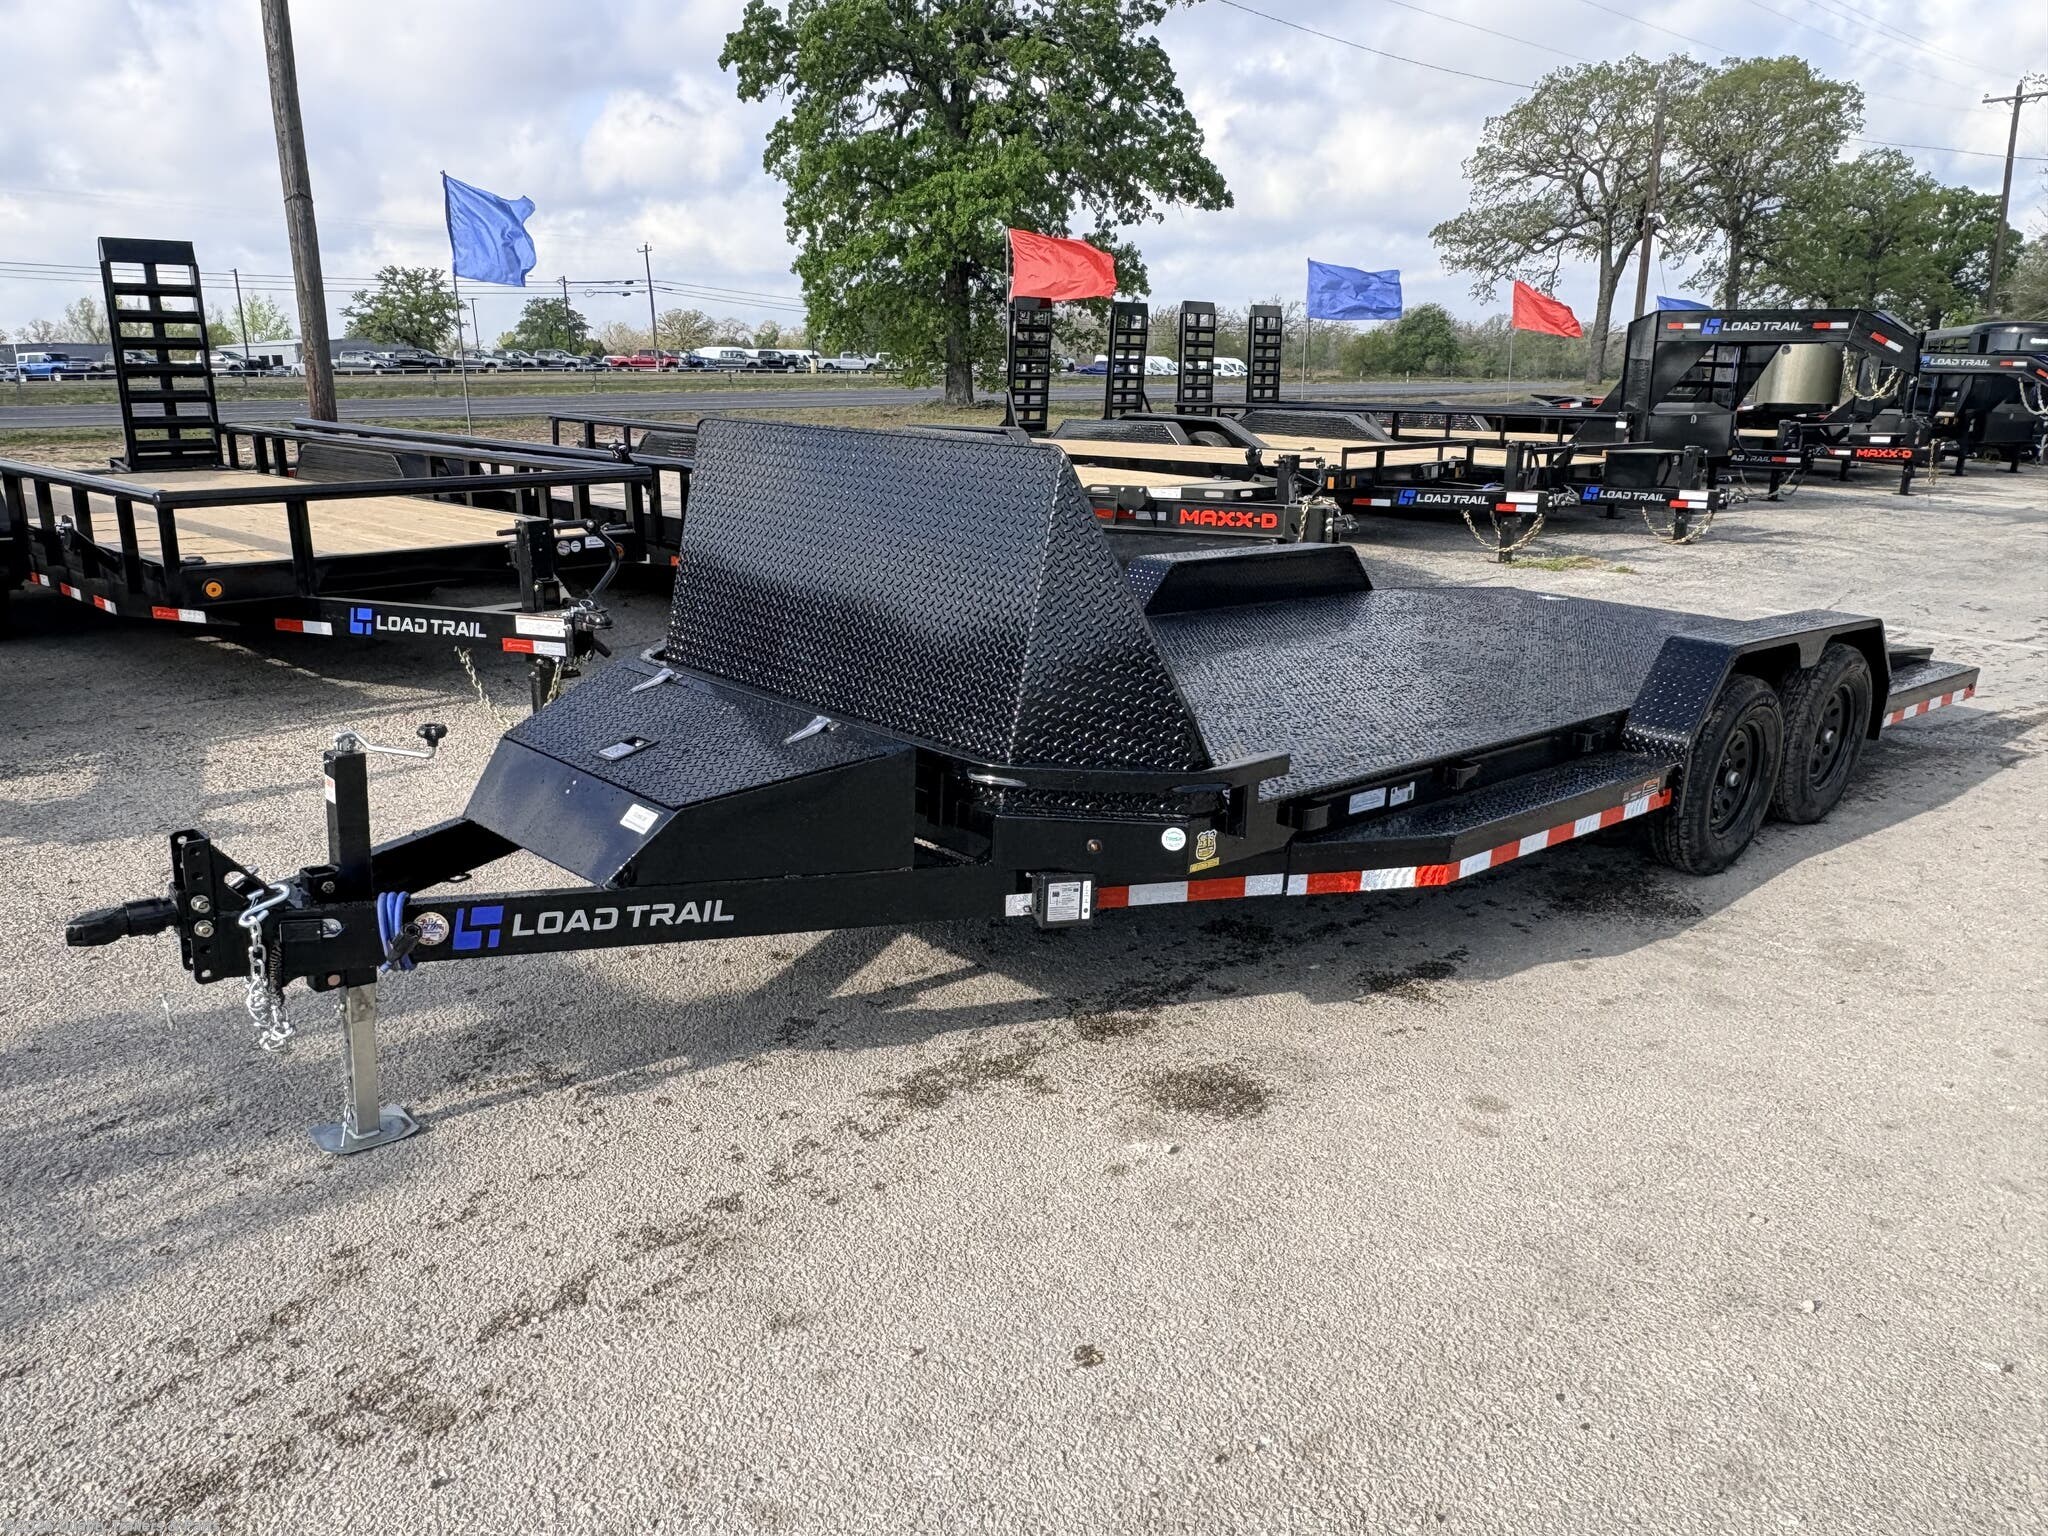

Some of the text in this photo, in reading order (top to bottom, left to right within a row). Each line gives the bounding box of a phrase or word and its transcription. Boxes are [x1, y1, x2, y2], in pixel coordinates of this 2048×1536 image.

[1722, 321, 1803, 331] LOAD TRAIL
[1930, 358, 1991, 367] LOAD TRAIL
[1856, 448, 1913, 459] MAXX-D
[1416, 493, 1490, 505] LOAD TRAIL
[1599, 489, 1666, 502] LOAD TRAIL
[1179, 508, 1278, 529] MAXX-D
[376, 614, 487, 639] LOAD TRAIL
[511, 899, 735, 937] LOAD TRAIL
